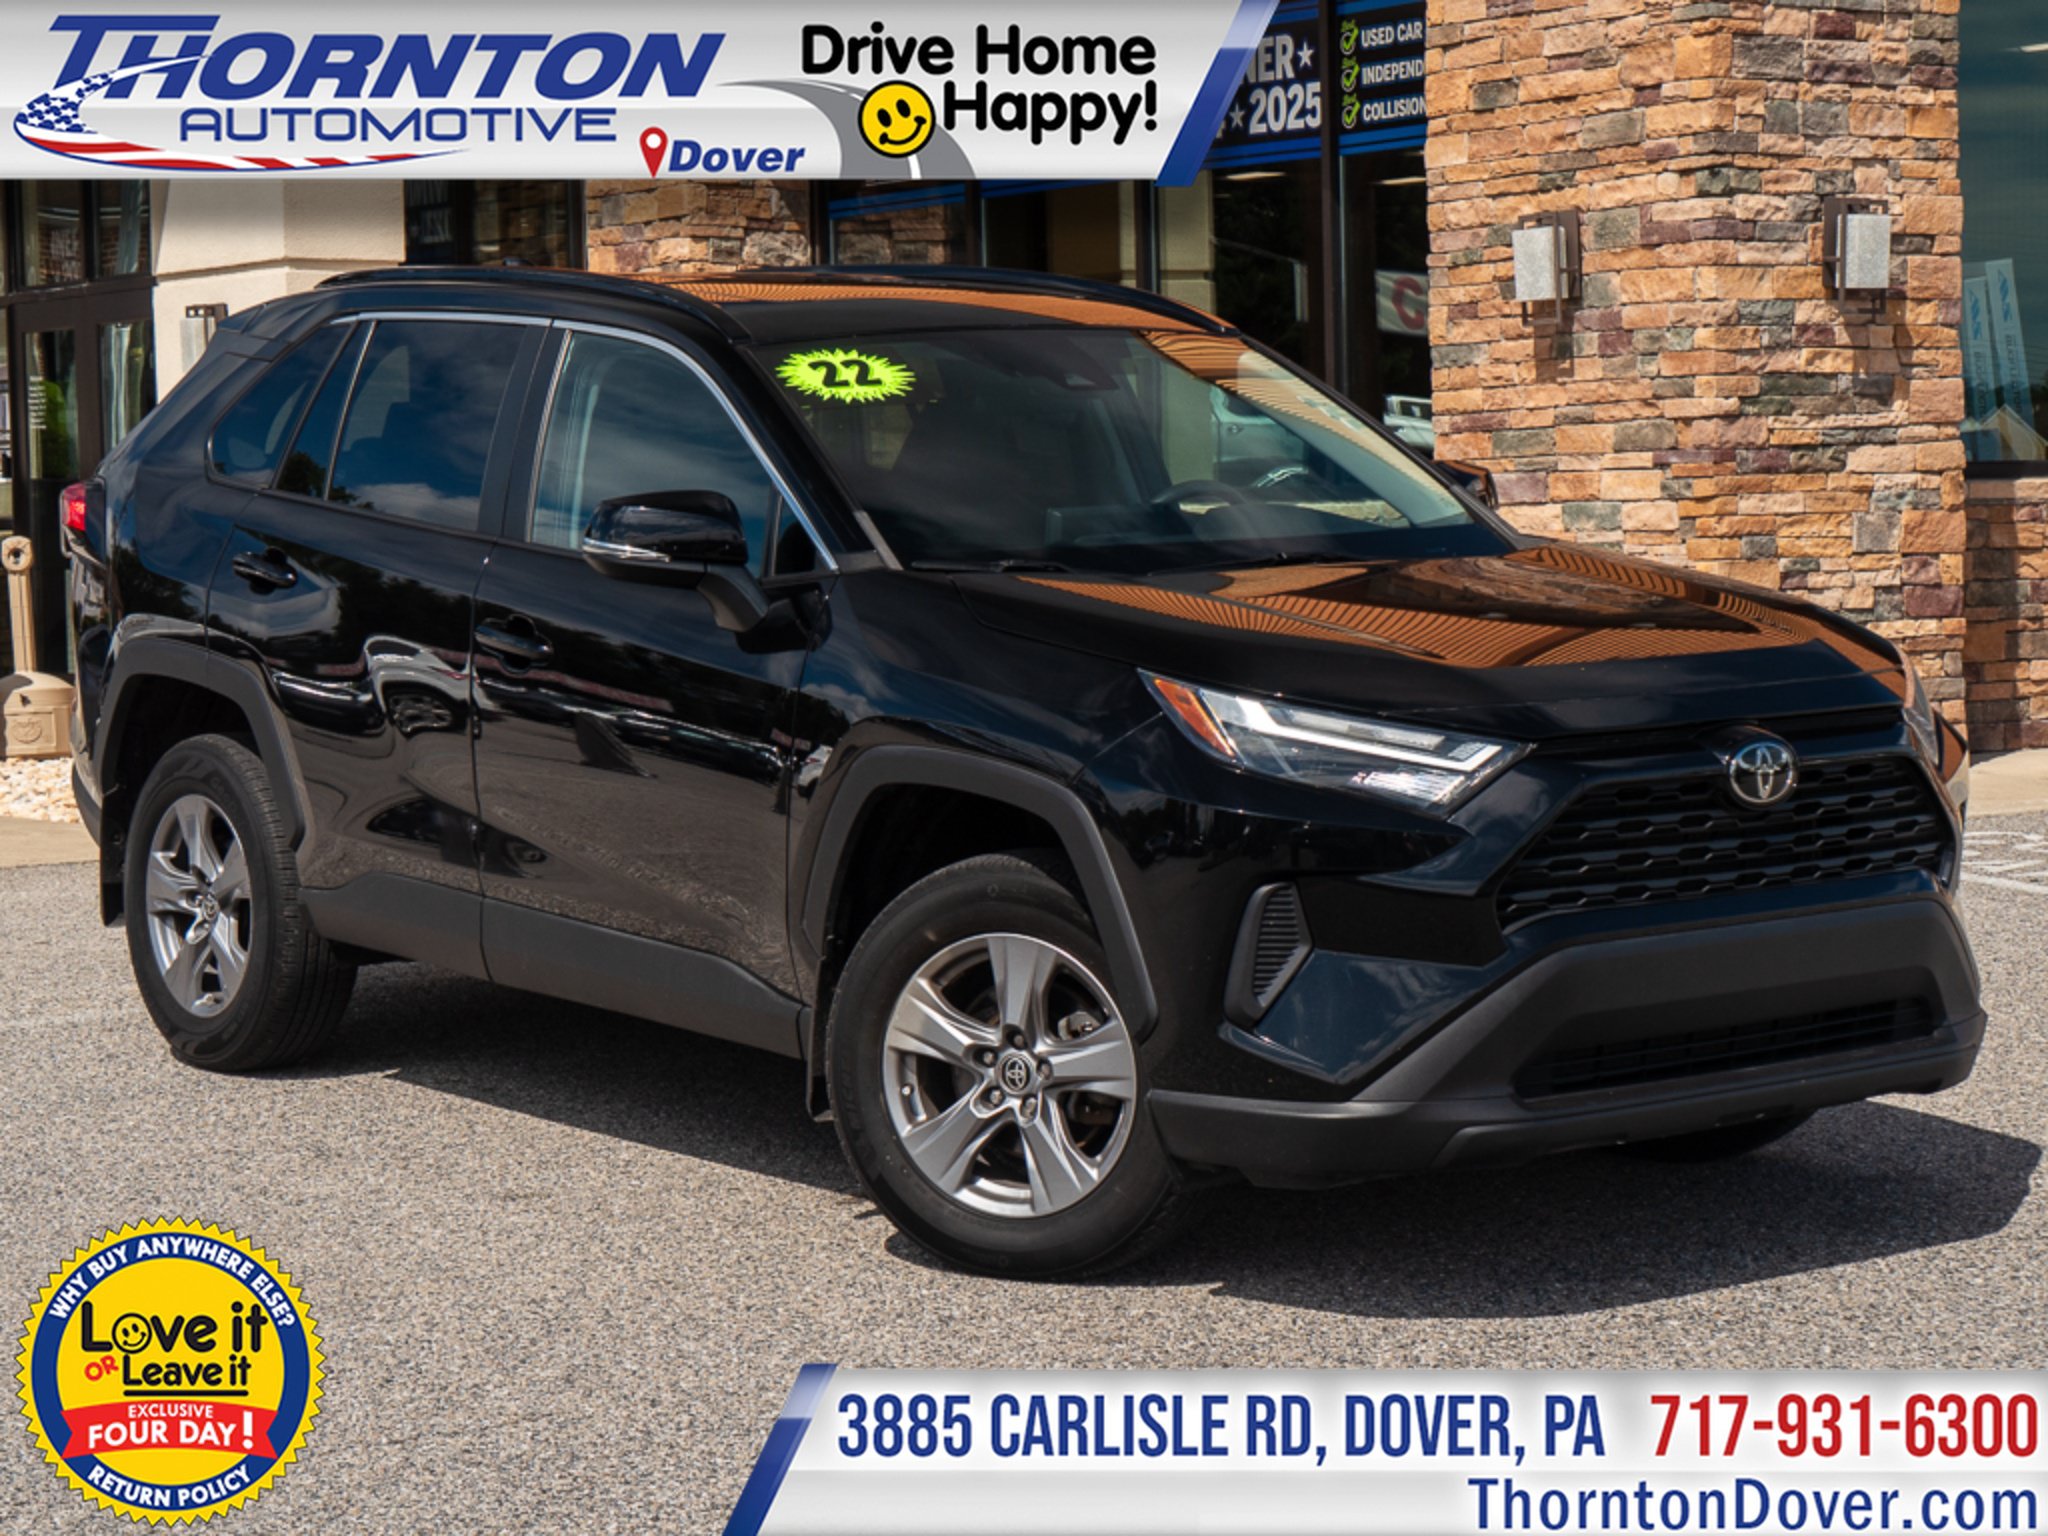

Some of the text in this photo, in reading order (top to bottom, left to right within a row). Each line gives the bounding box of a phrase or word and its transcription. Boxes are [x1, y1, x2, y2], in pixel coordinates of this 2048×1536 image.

[1361, 25, 1395, 47] USED
[1397, 21, 1424, 43] CAR
[1249, 81, 1322, 135] 2025
[807, 359, 883, 388] 22
